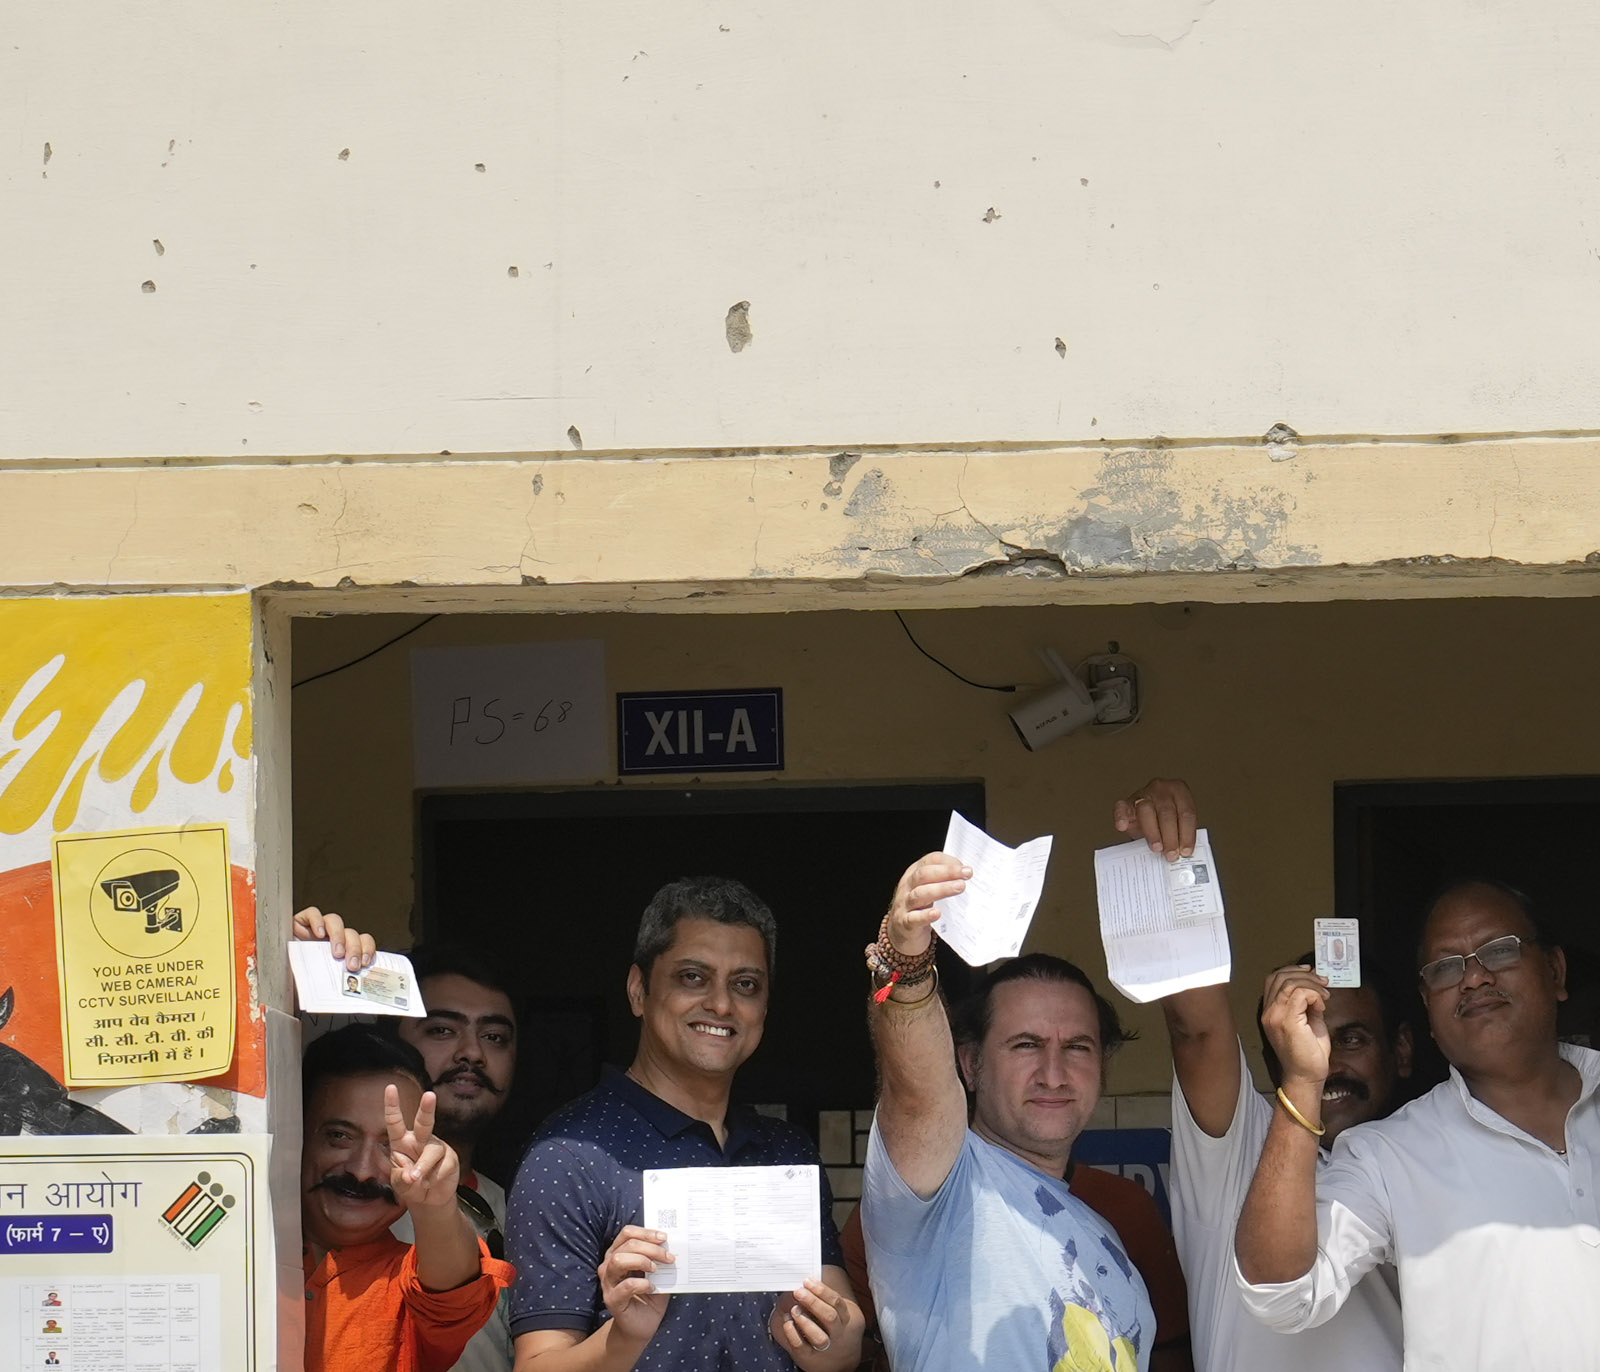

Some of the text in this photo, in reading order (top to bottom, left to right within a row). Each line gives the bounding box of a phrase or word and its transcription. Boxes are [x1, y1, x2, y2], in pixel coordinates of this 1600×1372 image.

[644, 707, 758, 757] XII-A
[93, 960, 204, 977] YOU ARE UNDER
[101, 976, 198, 992] WEB CAMERA/
[78, 988, 221, 1009] CCTV SURVEILLANCE
[93, 1016, 123, 1029] आप
[155, 1010, 196, 1025] कैमरा
[84, 1032, 109, 1048] सी.
[114, 1031, 139, 1047] सी.
[170, 1028, 191, 1043] वी.
[196, 1025, 215, 1041] की
[97, 1050, 160, 1066] निगरानी
[165, 1047, 178, 1062] में
[45, 1170, 143, 1209] आयोग
[5, 1221, 43, 1245] (फार्म
[51, 1228, 62, 1242] 7
[91, 1221, 110, 1245] ए)
